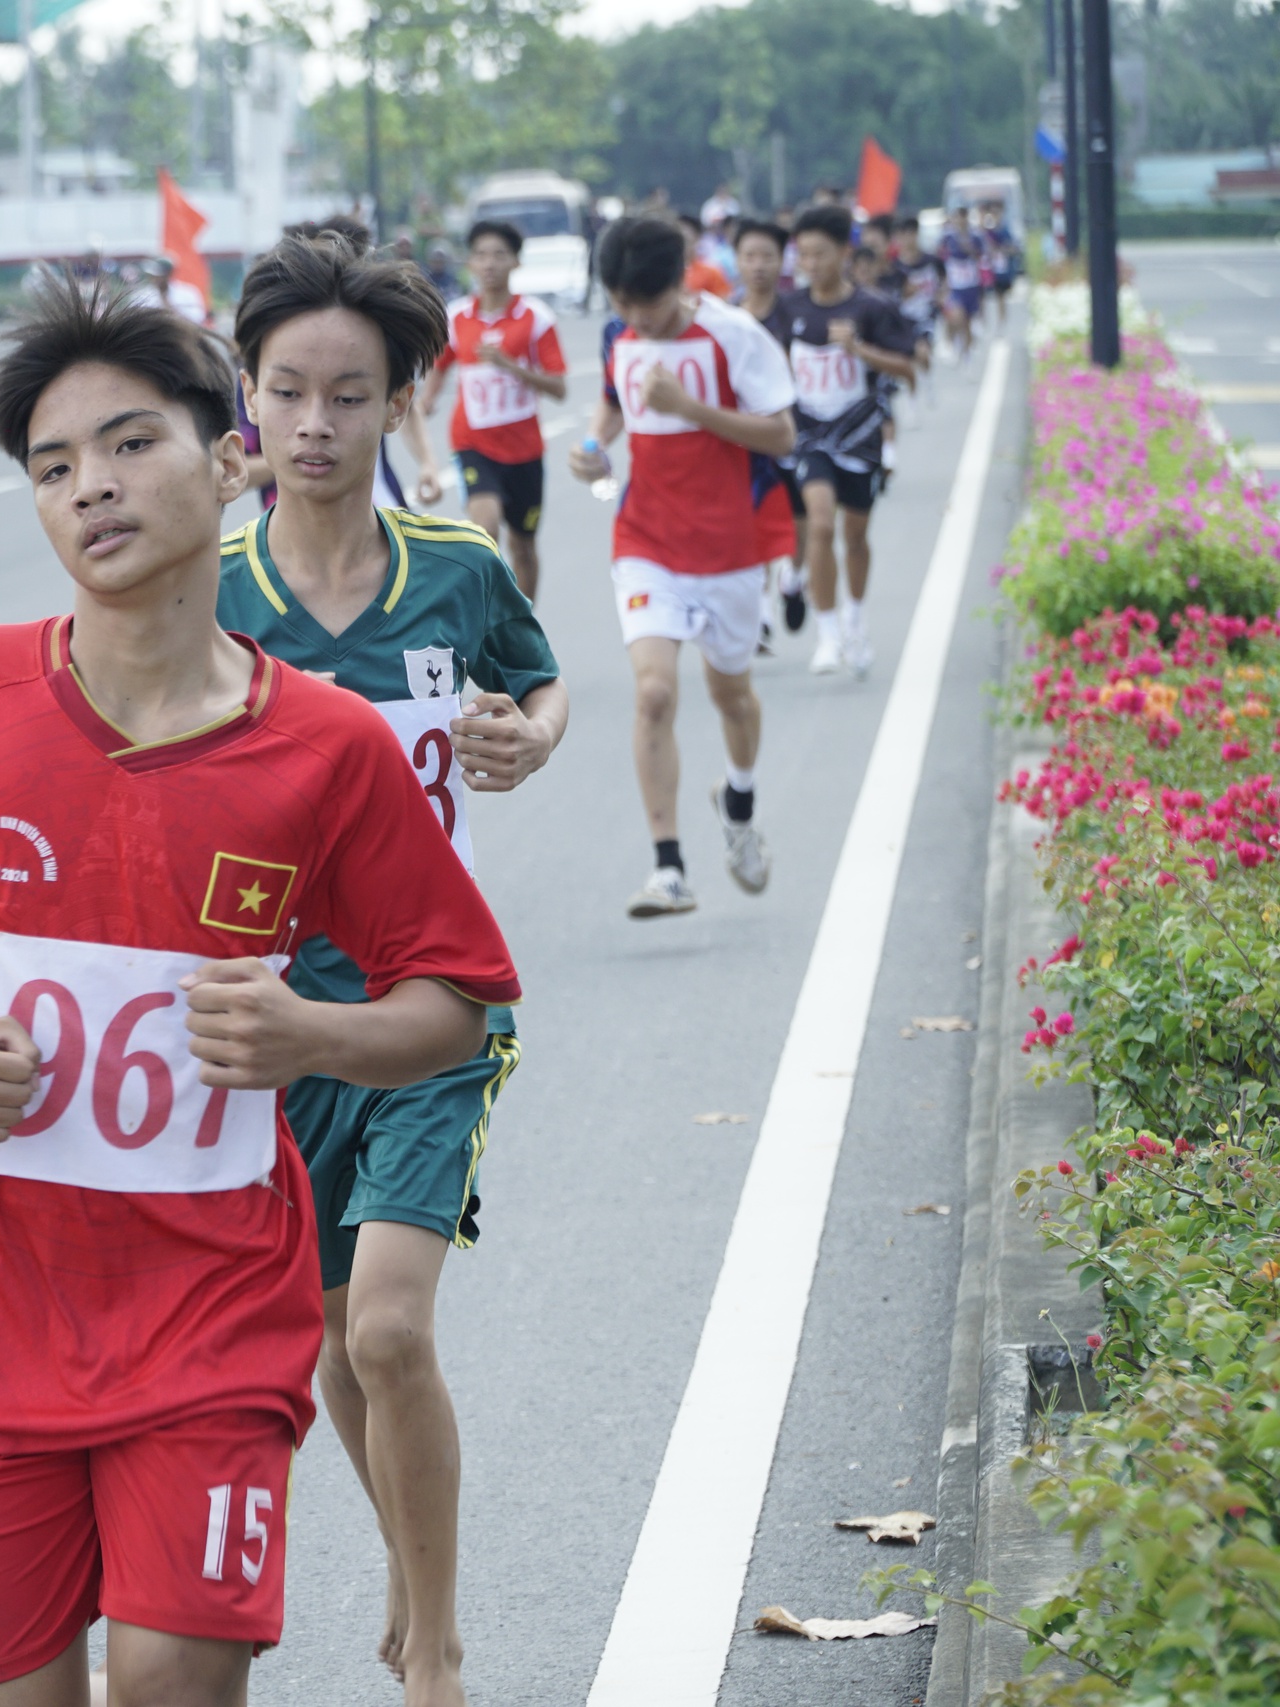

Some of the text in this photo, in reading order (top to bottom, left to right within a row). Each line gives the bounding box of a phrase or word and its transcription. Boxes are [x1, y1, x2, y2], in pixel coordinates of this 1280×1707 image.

[625, 356, 707, 417] 60
[0, 868, 29, 883] 2024
[201, 1482, 273, 1586] 15
